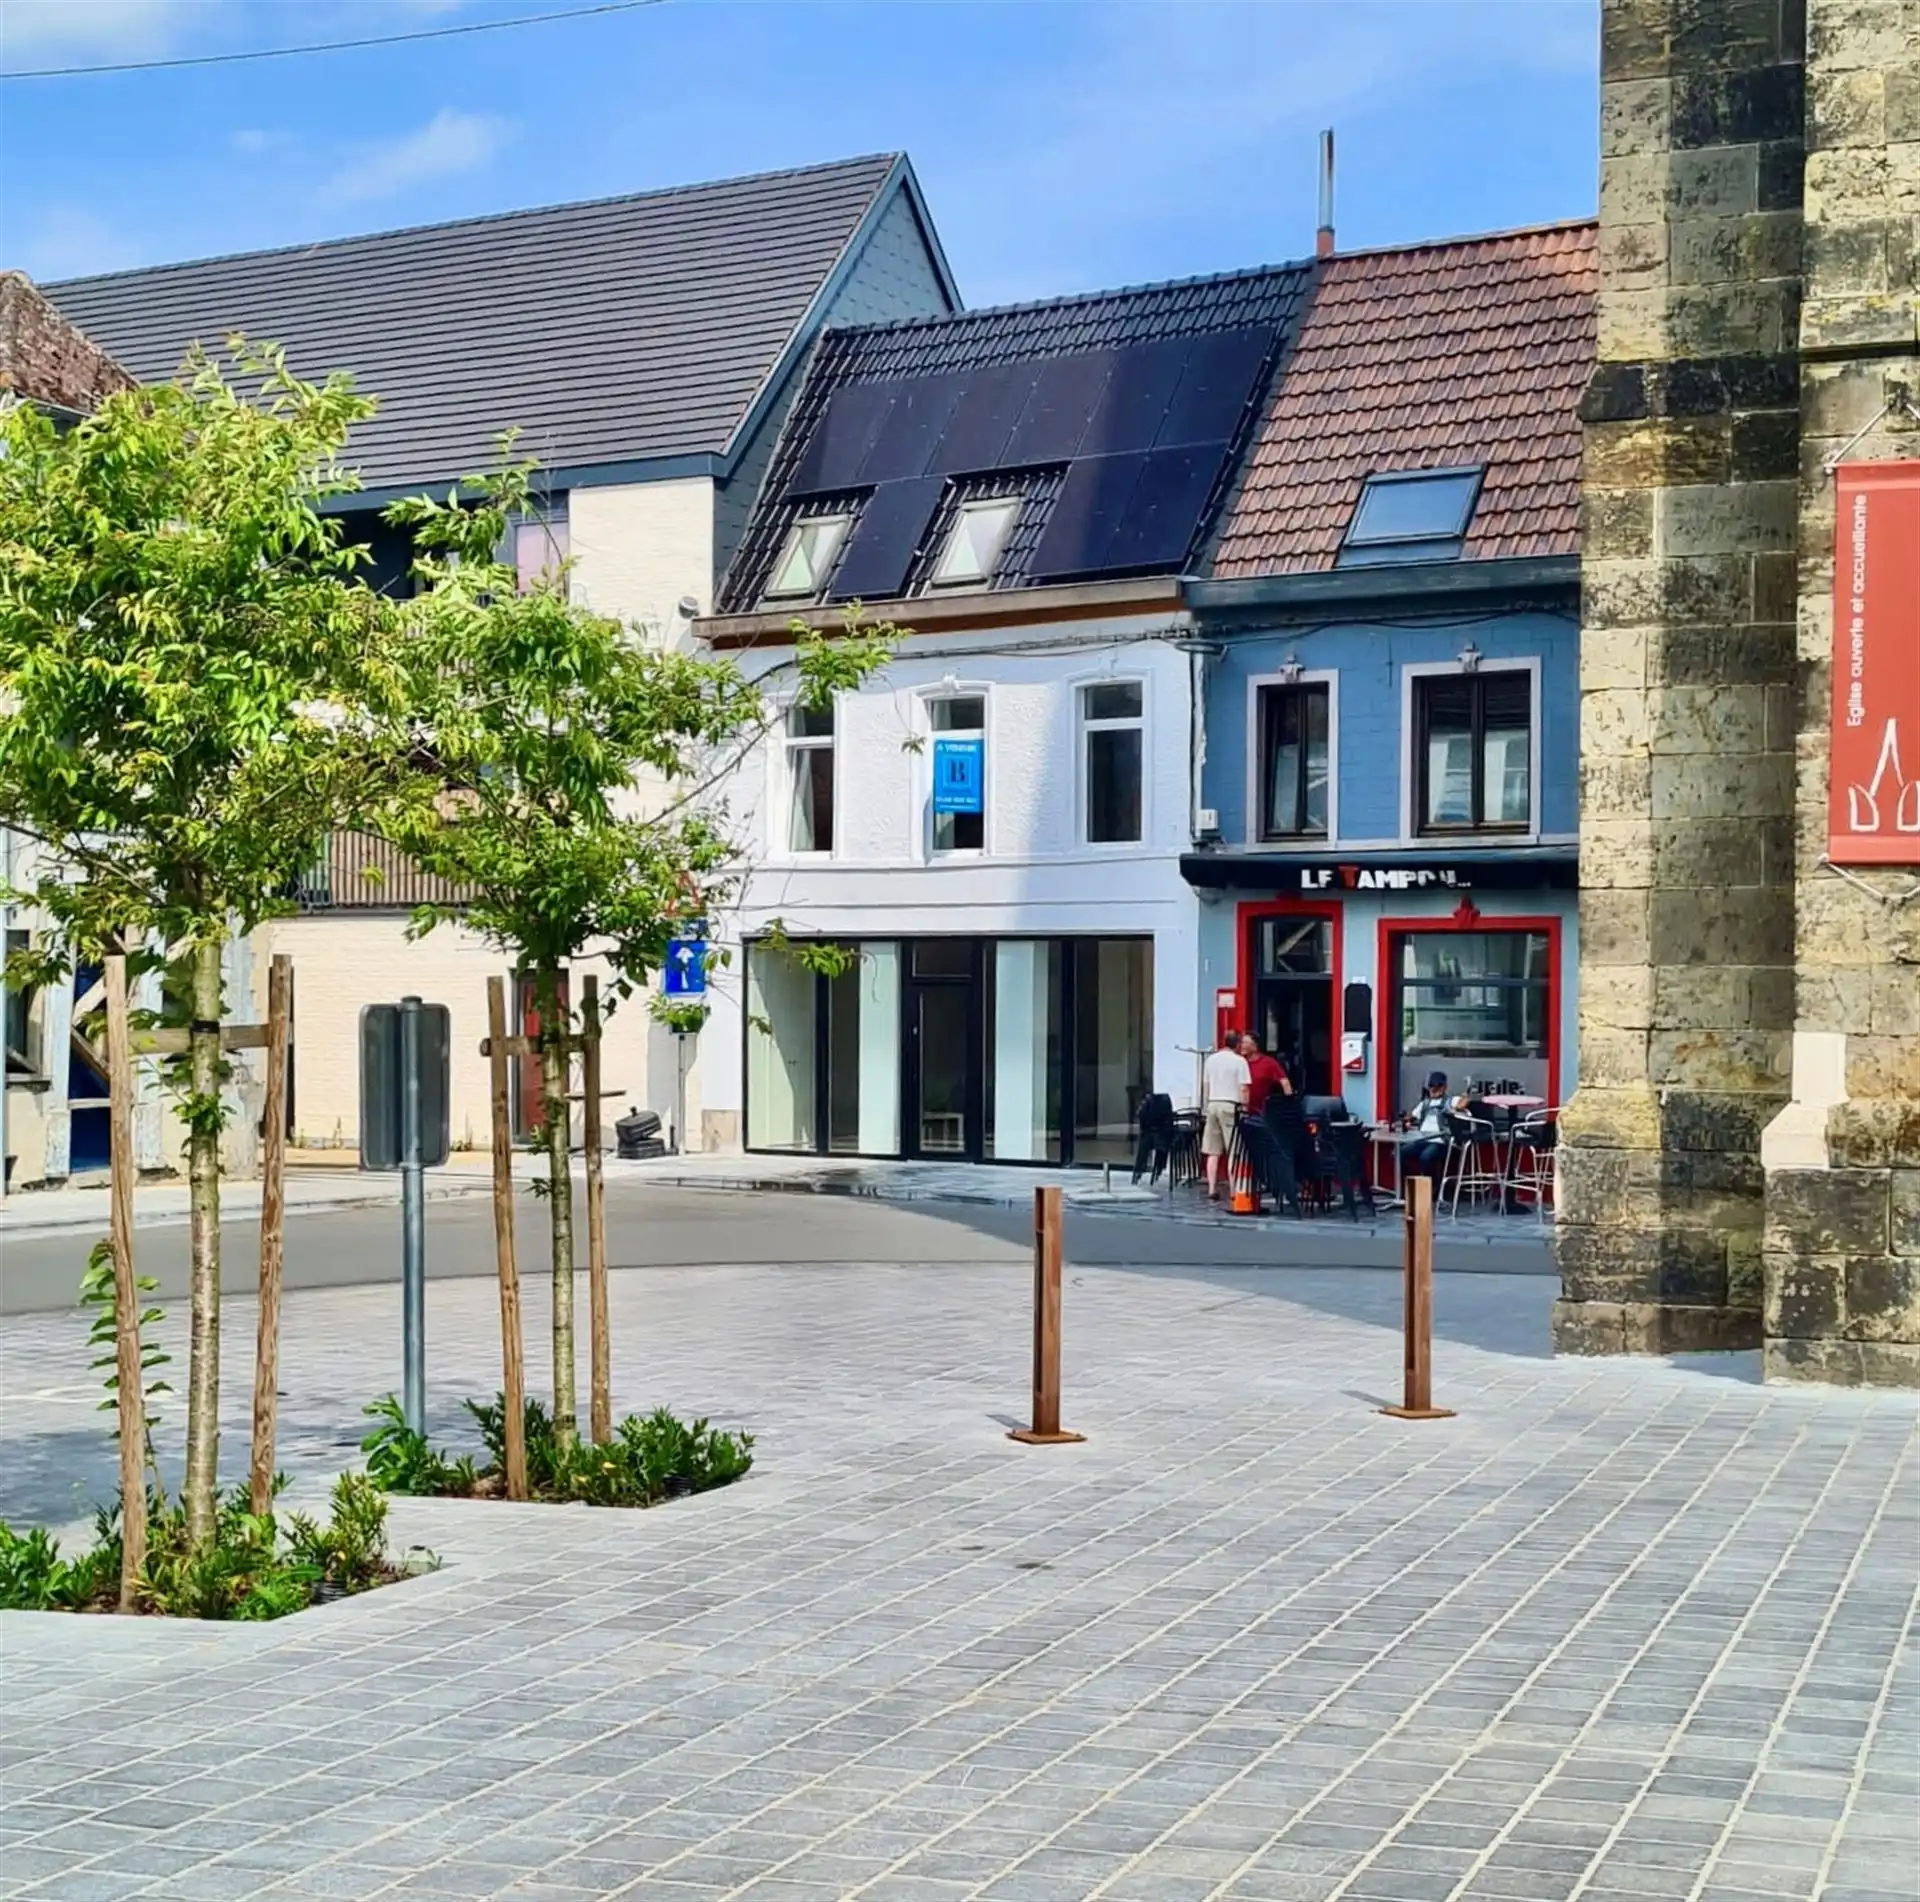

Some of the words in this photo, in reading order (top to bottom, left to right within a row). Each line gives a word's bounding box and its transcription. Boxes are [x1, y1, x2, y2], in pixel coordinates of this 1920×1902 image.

[1851, 495, 1867, 594] accueillante
[1850, 598, 1864, 613] et
[1849, 617, 1864, 678] ouverte
[1847, 682, 1865, 727] Eglise
